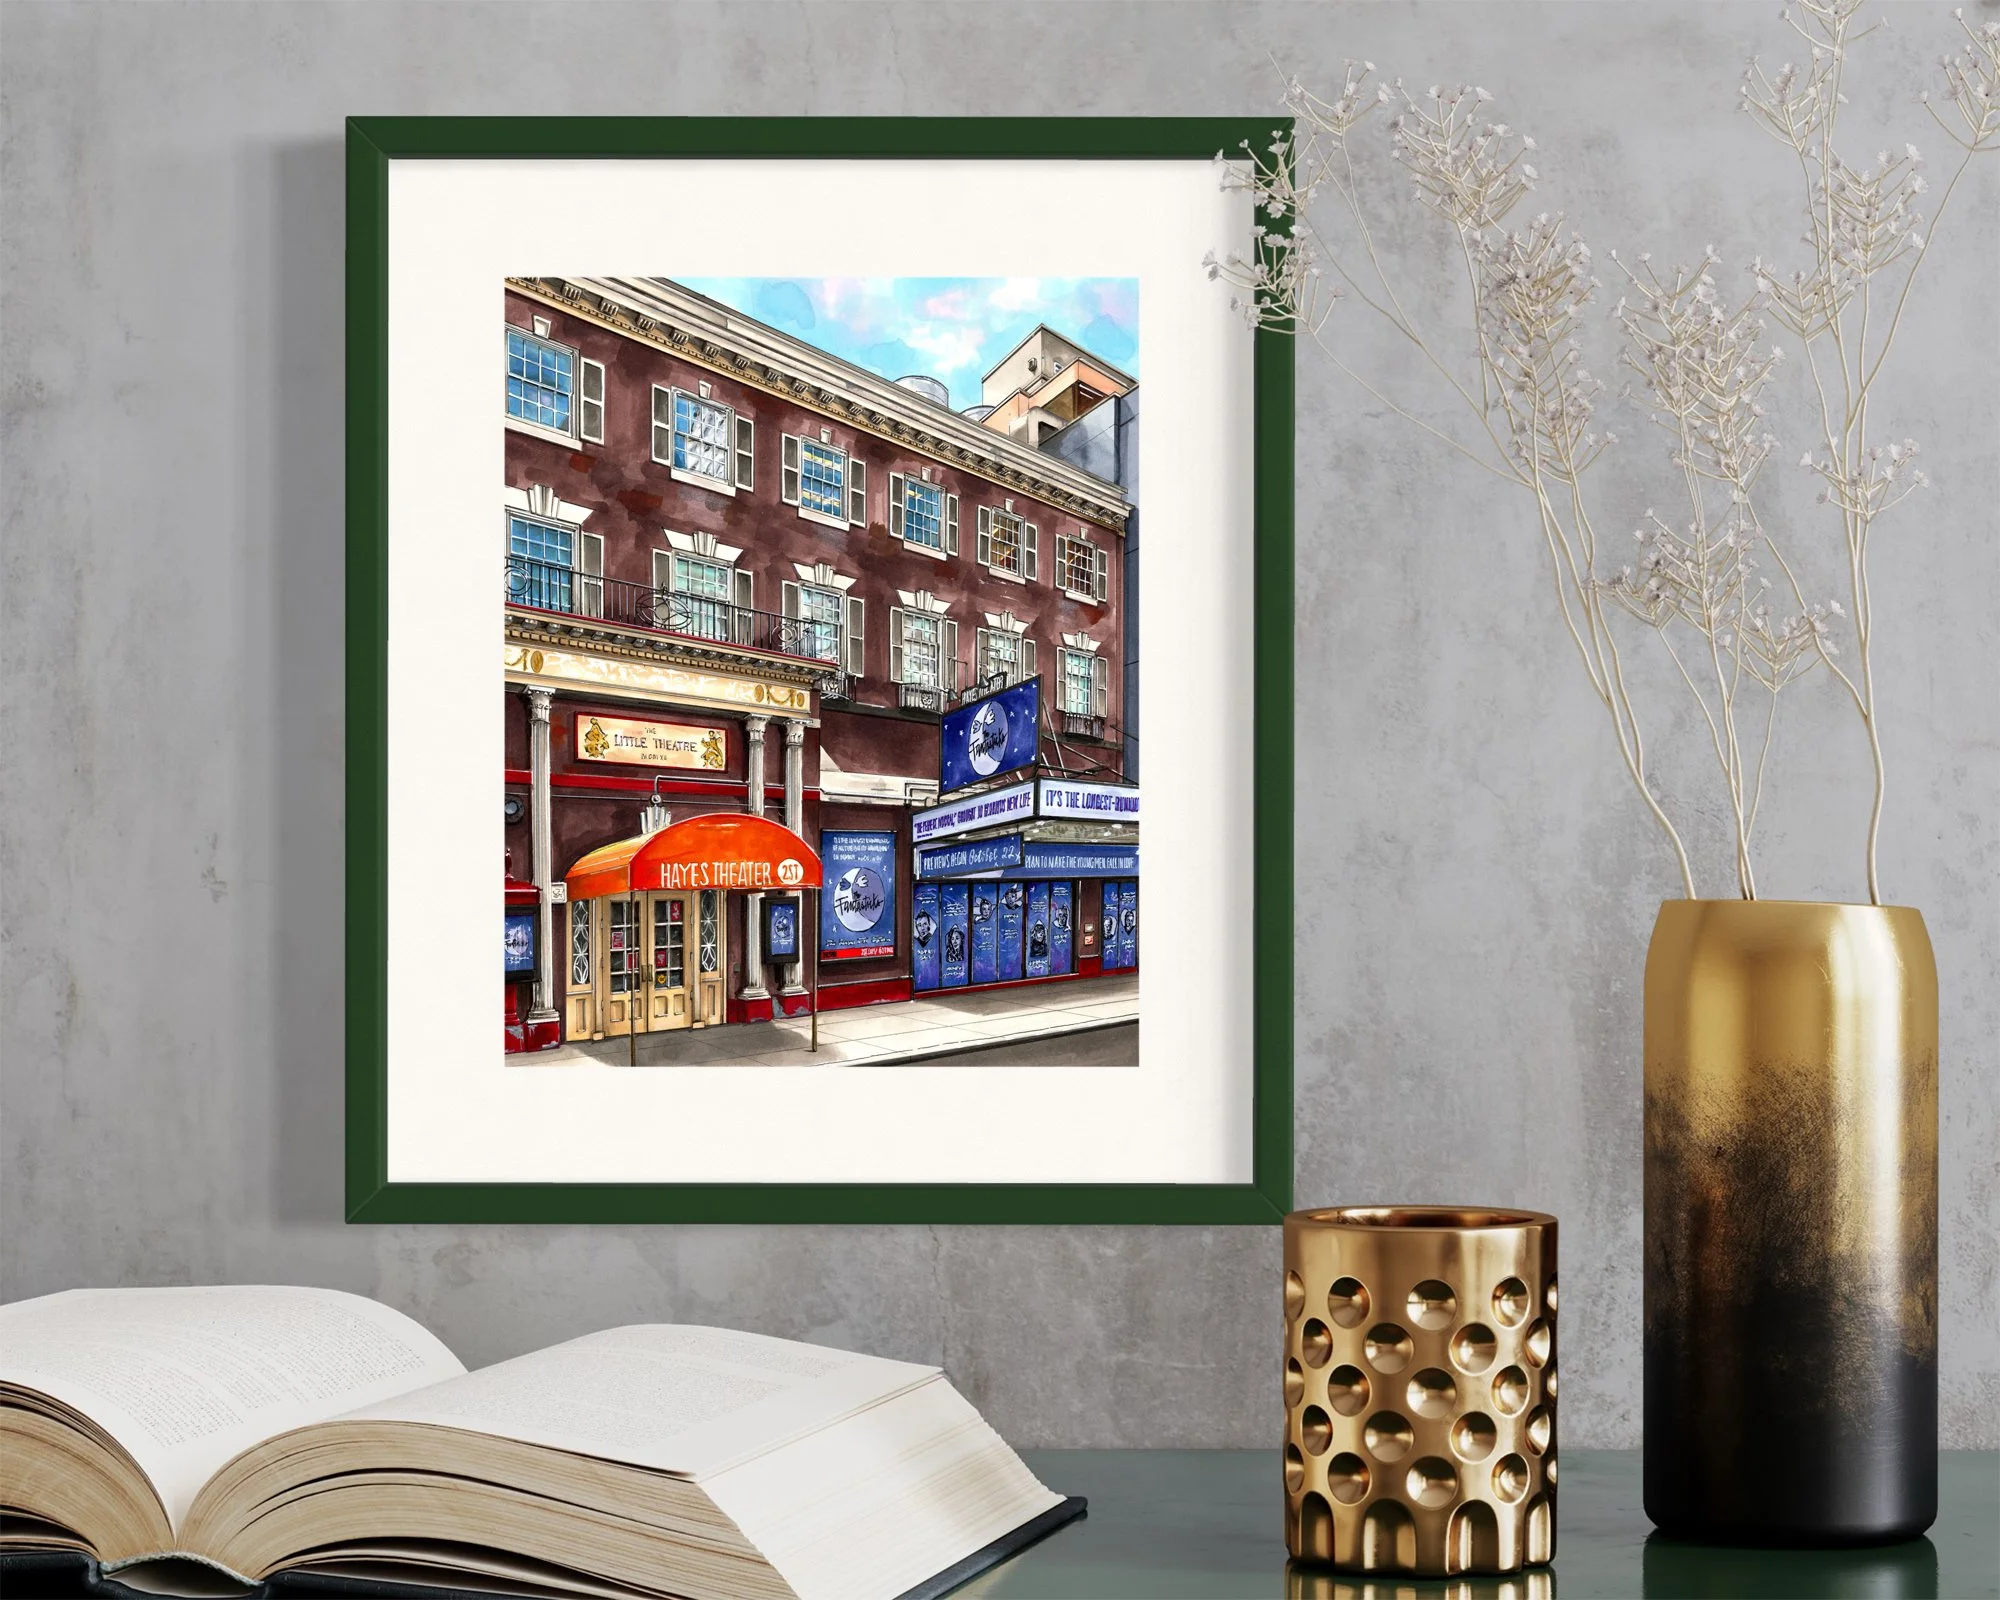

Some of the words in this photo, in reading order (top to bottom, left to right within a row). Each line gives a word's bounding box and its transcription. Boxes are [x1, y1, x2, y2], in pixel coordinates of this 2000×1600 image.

[614, 734, 648, 749] LITTLE
[653, 737, 698, 752] THEATRE
[1019, 791, 1031, 808] LIFE
[1045, 790, 1063, 807] IT'S
[1065, 791, 1080, 808] THE
[1040, 855, 1048, 868] TO
[1066, 855, 1077, 868] THE
[660, 862, 709, 888] HAYES
[712, 861, 774, 887] THEATER
[782, 864, 798, 880] 2ST
